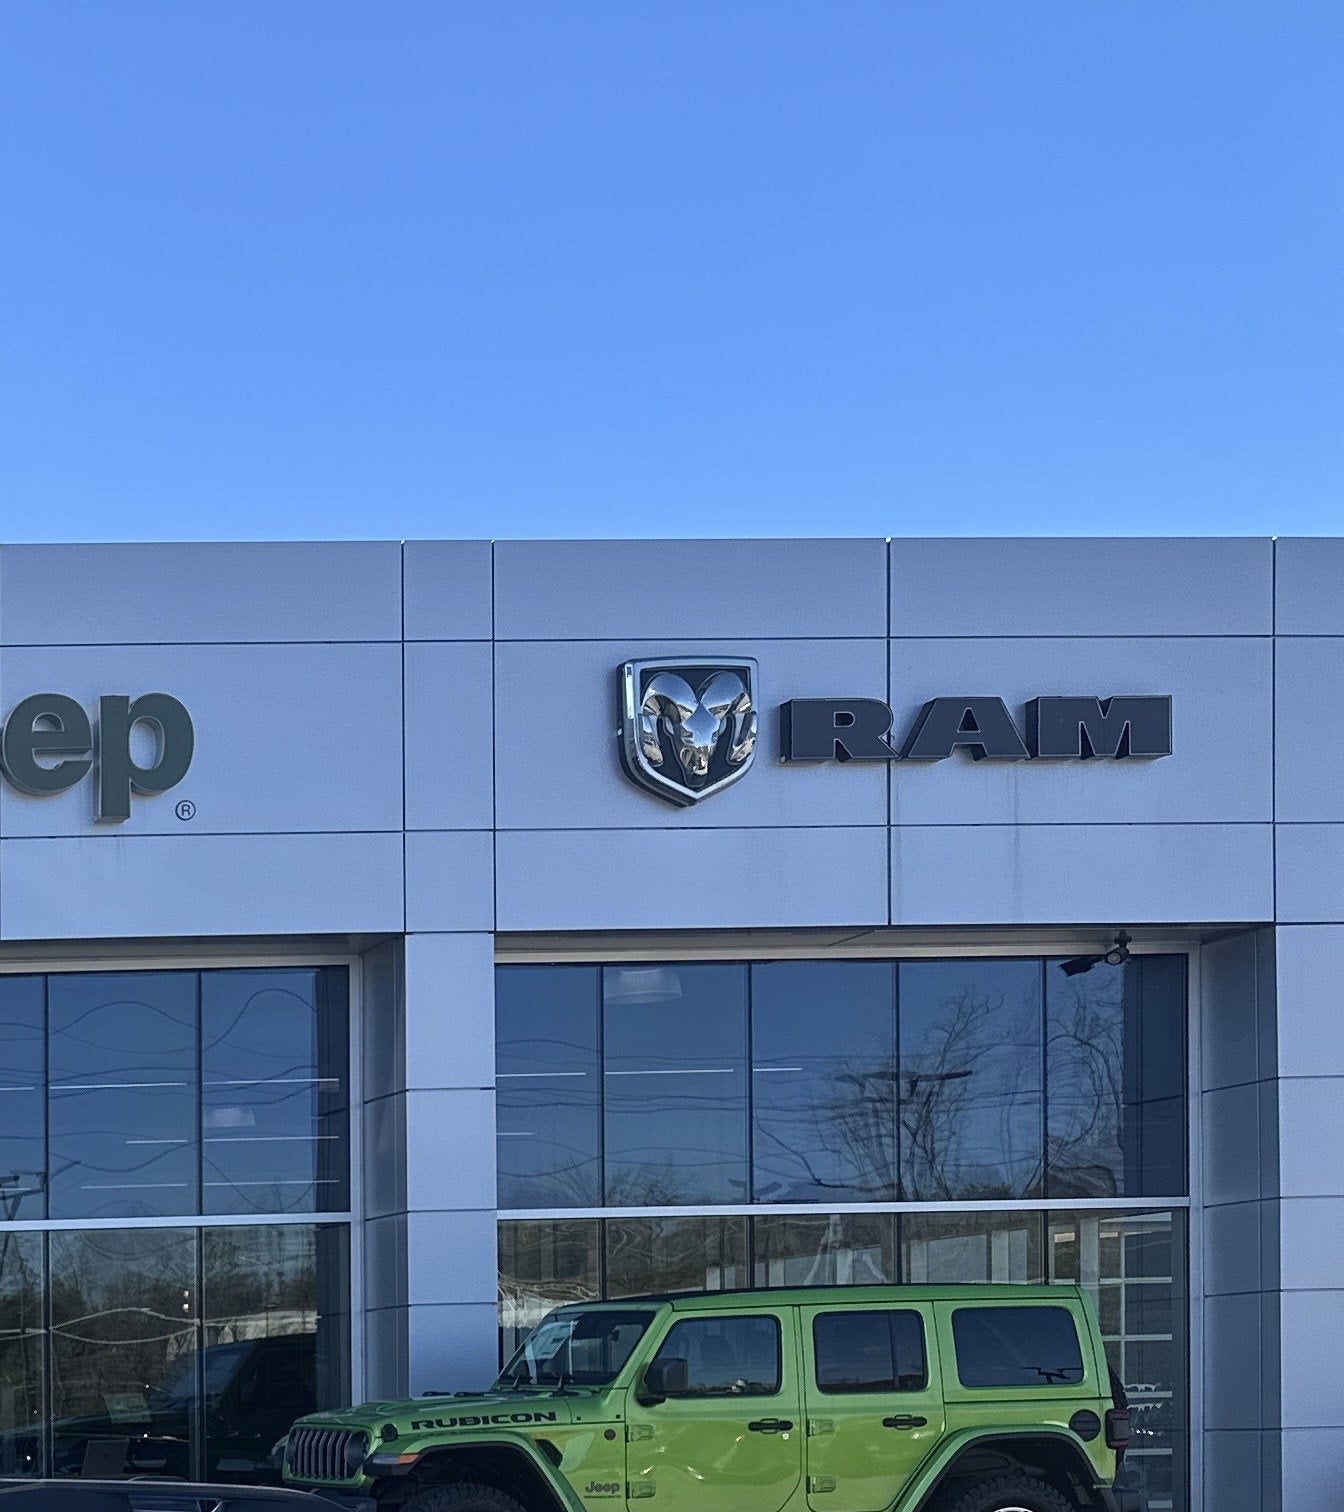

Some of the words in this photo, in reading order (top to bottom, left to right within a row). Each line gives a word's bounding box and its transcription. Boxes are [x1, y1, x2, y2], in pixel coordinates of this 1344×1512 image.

[779, 695, 1173, 763] RAM
[410, 1411, 557, 1431] RUBICON
[585, 1481, 621, 1495] Jeep
